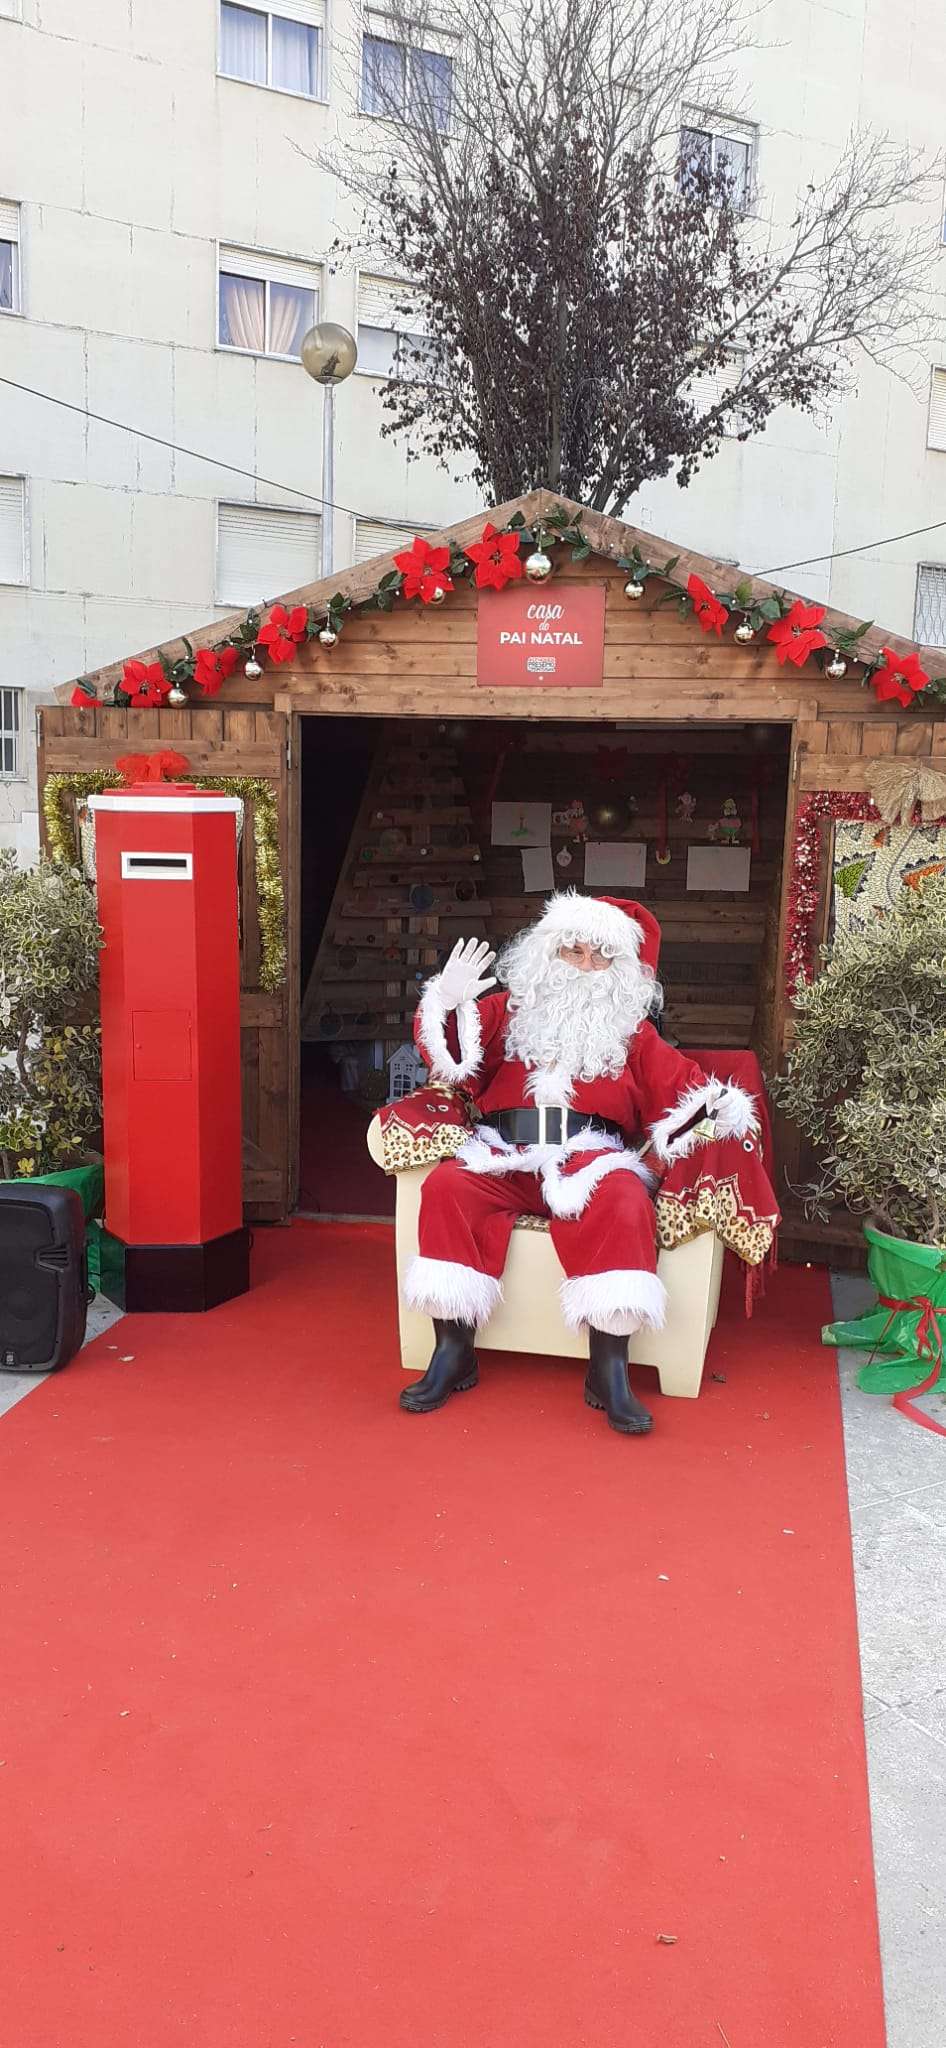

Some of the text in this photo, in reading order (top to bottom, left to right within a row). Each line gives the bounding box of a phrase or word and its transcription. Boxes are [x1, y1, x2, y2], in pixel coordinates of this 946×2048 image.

[527, 604, 565, 619] casa
[538, 618, 550, 631] do
[500, 632, 583, 645] PAI NATAL
